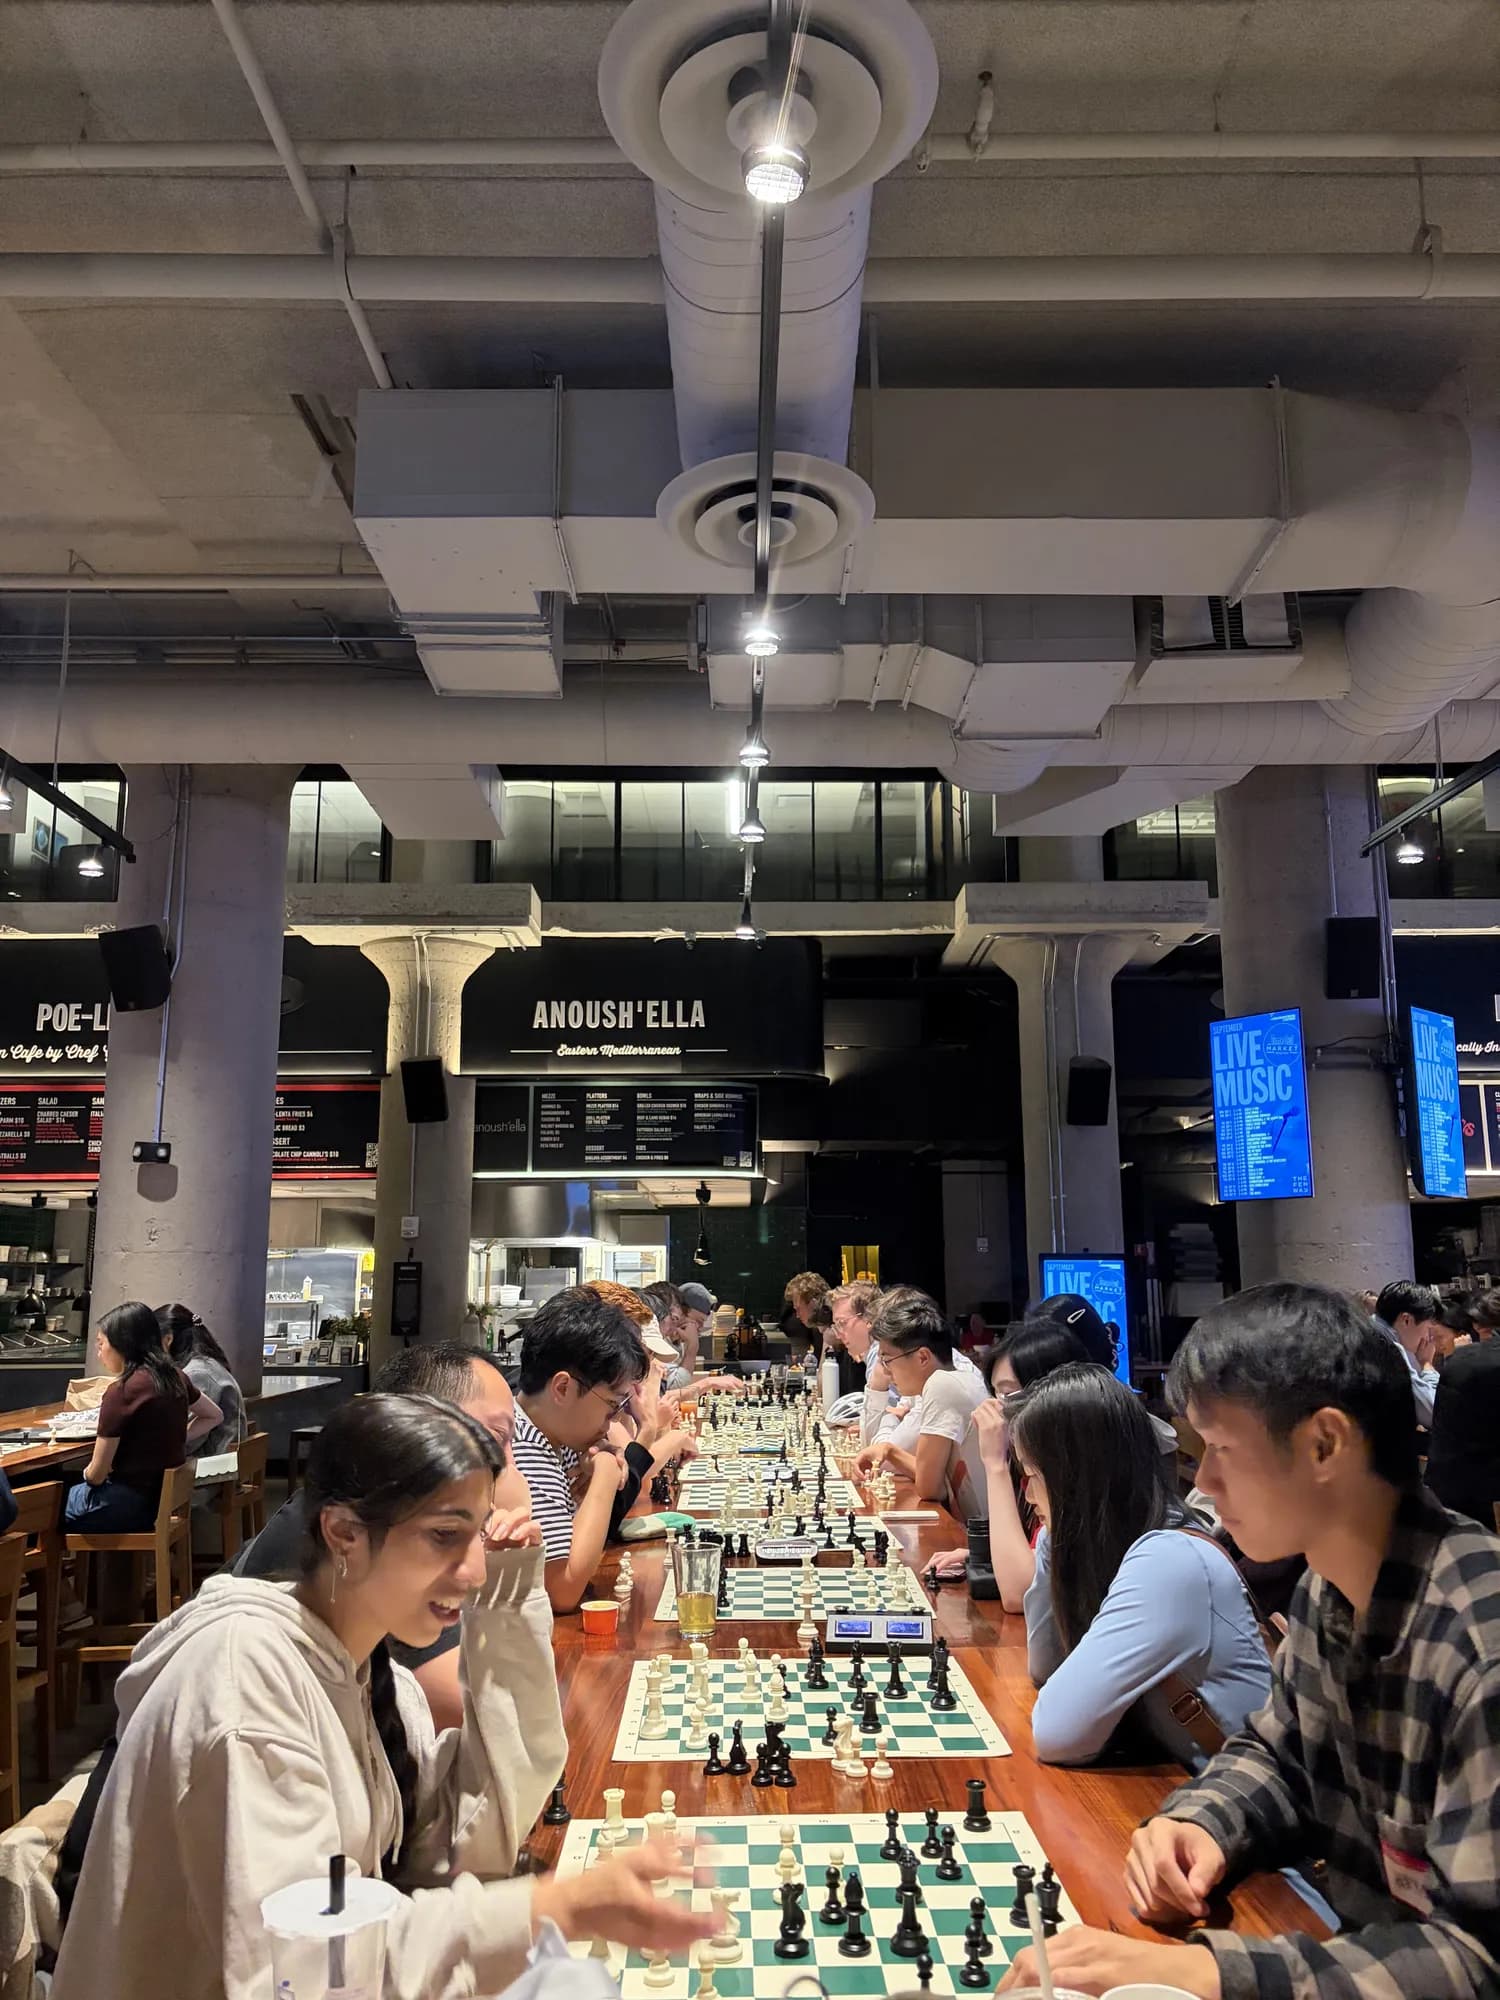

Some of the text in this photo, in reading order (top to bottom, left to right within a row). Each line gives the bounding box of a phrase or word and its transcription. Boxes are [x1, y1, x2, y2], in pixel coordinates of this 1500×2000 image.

[36, 1003, 110, 1032] POE-L
[533, 1000, 706, 1029] ANOUSH'ELLA
[1212, 1022, 1243, 1035] SEPTEMBER
[10, 1044, 44, 1063] Cafe
[45, 1046, 63, 1063] by
[65, 1044, 99, 1063] Chef
[556, 1044, 682, 1057] Eastern Mediterranean
[1213, 1030, 1264, 1071] LIVE
[1412, 1021, 1441, 1063] LIVE
[1216, 1063, 1293, 1108] MUSIC
[1415, 1060, 1455, 1103] MUSIC
[38, 1097, 58, 1105] SALAD
[1047, 1271, 1093, 1300] LIVE
